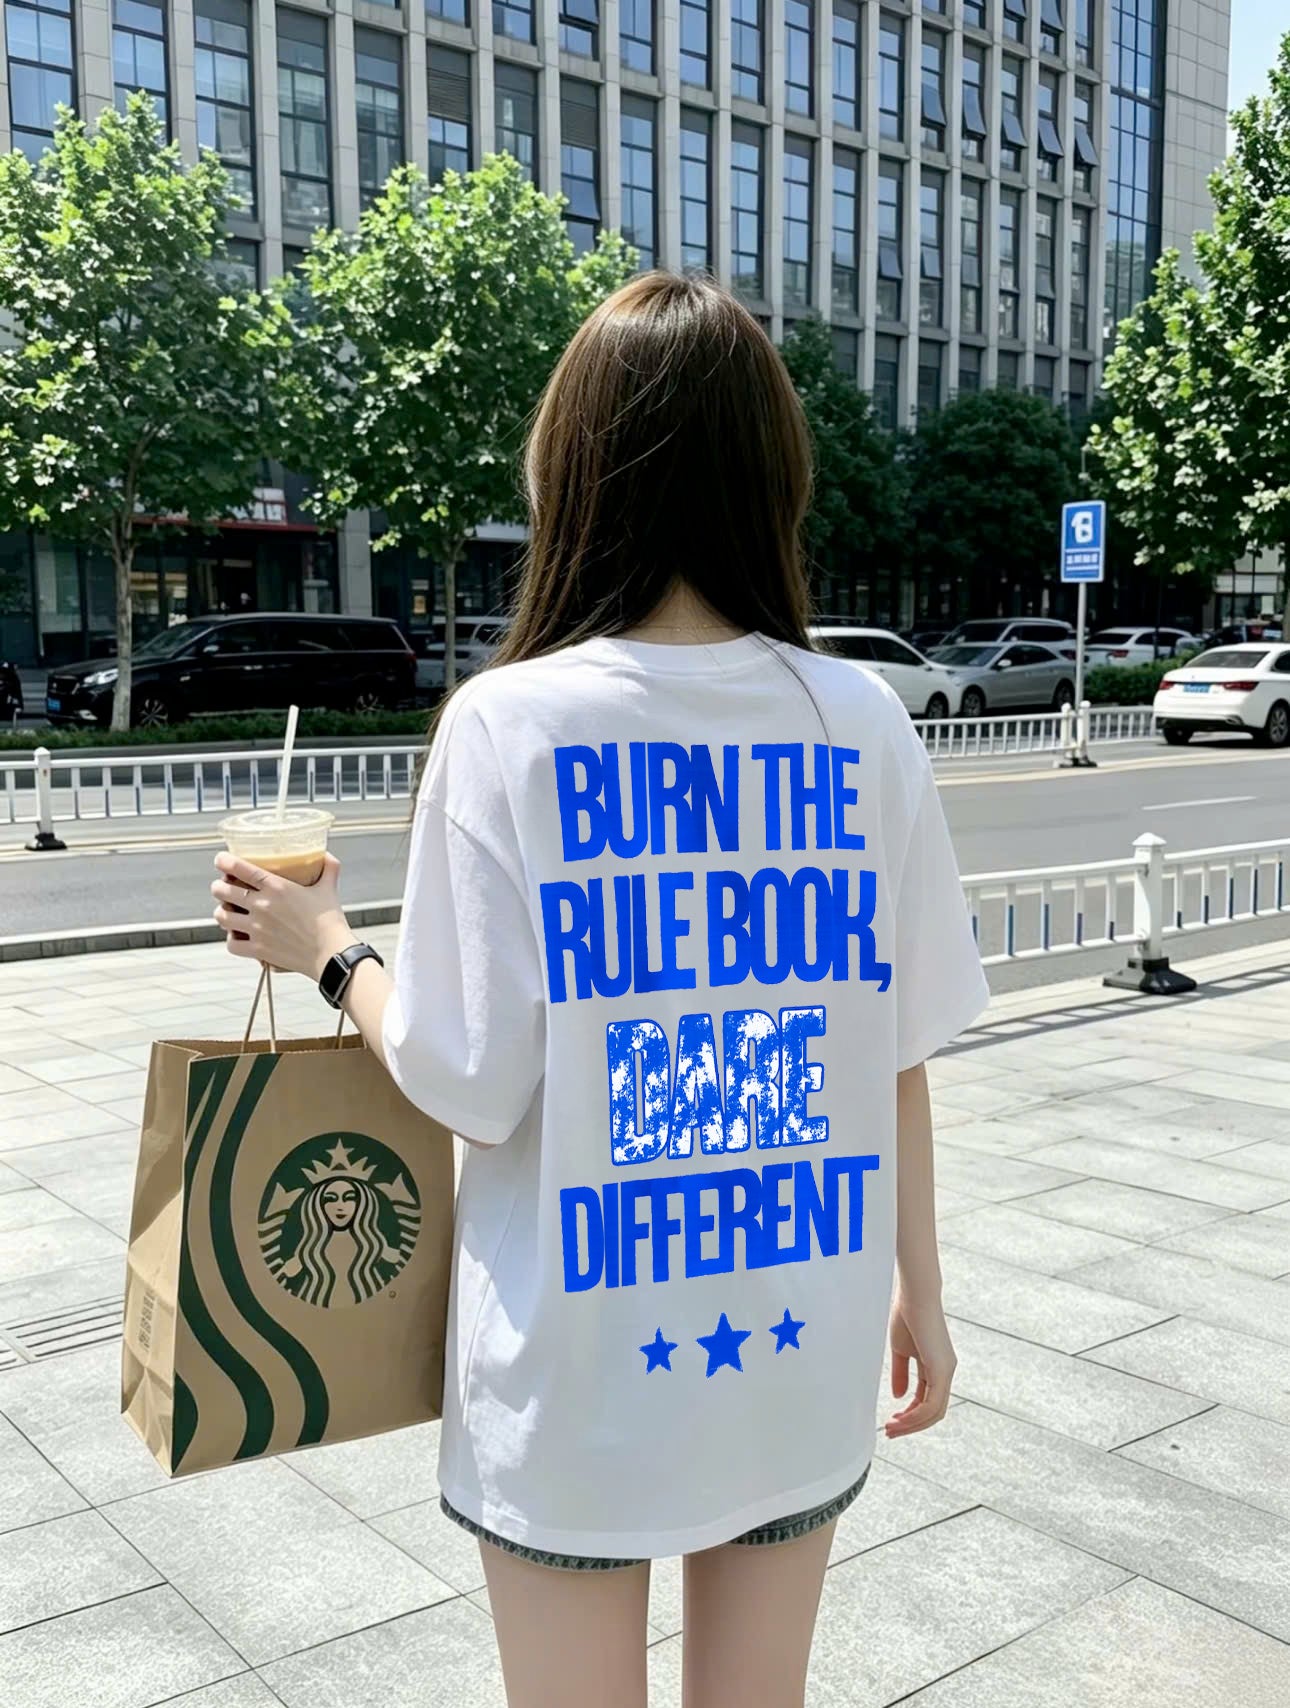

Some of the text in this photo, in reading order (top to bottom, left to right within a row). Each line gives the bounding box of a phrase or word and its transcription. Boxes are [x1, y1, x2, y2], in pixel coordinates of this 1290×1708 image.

[554, 742, 865, 862] BURN THE
[540, 867, 891, 1003] RULE BOOK,
[606, 1005, 829, 1166] DARE
[560, 1155, 879, 1292] DIFFERENT
